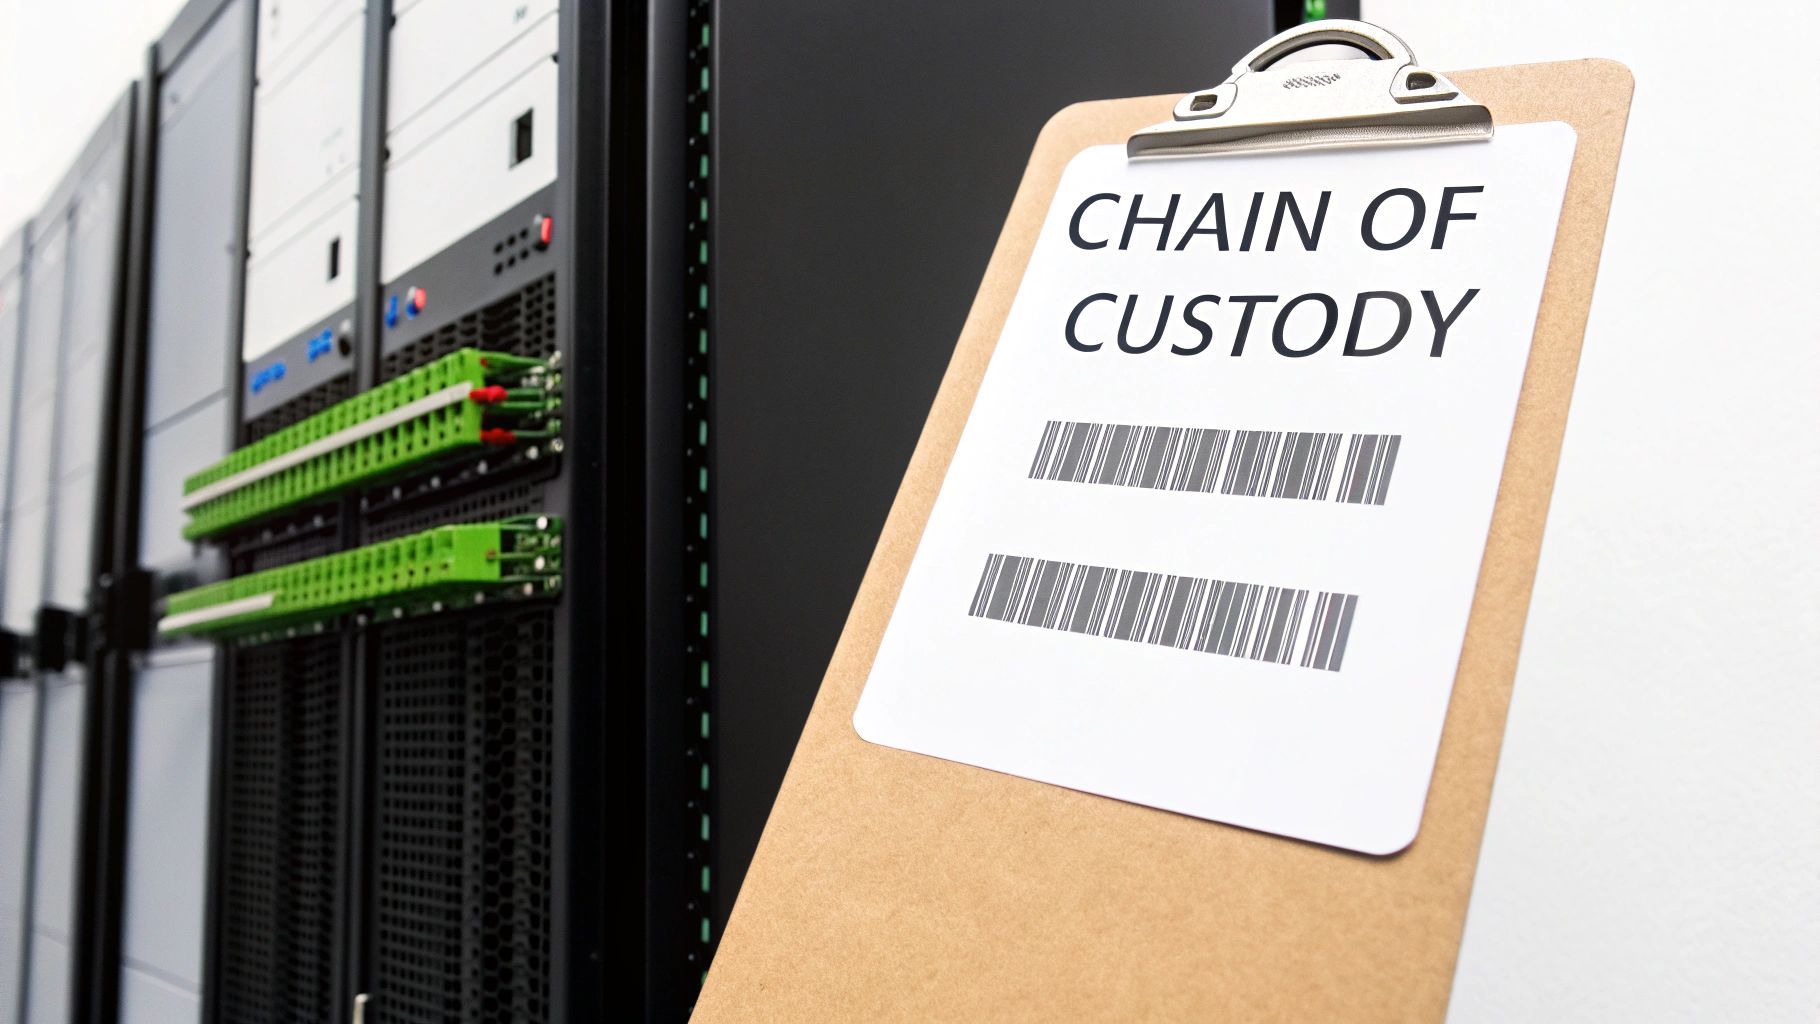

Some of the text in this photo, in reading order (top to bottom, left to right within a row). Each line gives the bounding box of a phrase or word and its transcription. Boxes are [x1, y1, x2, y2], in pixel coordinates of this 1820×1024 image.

[1068, 185, 1485, 252] CHAIN OF
[1065, 288, 1481, 358] CUSTODY
